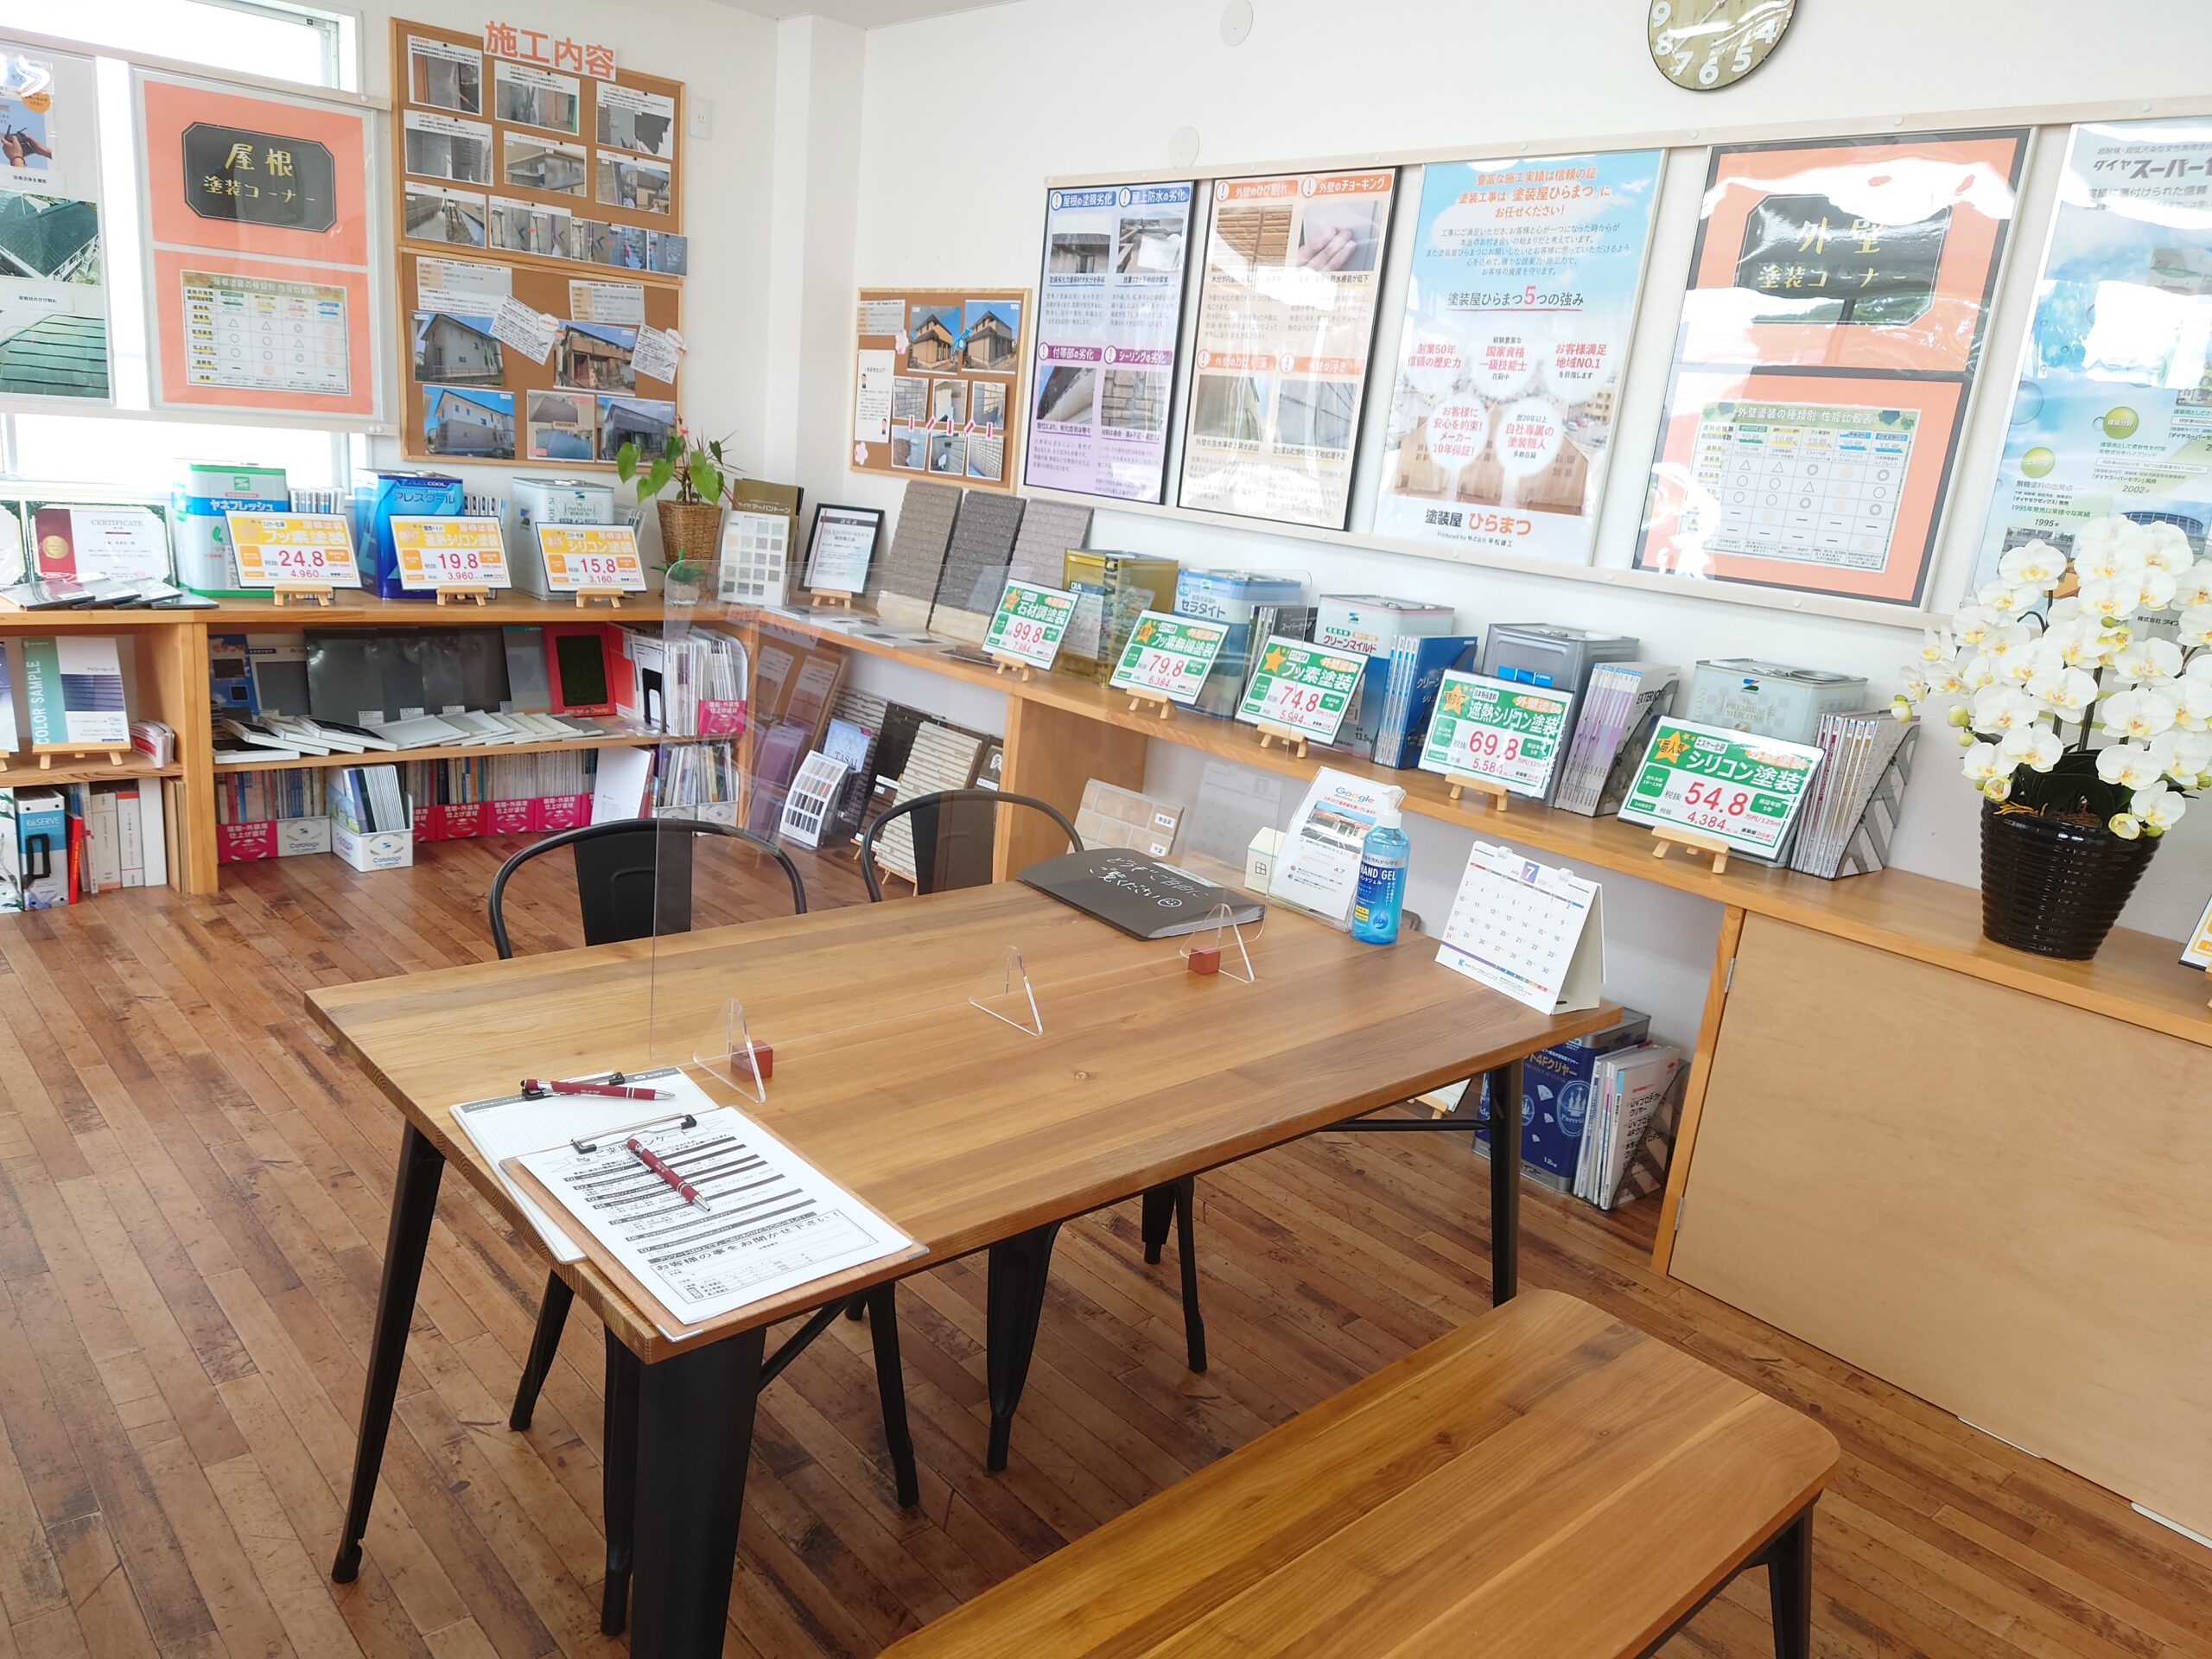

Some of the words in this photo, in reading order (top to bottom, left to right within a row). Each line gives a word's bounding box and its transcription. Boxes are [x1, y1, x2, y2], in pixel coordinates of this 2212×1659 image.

[1653, 2, 1671, 28] 9
[1755, 21, 1777, 43] 4
[486, 21, 615, 79] 施工内容
[1656, 31, 1673, 55] 8
[1673, 51, 1694, 76] 7
[1731, 47, 1753, 72] 5
[1699, 57, 1719, 84] 6
[226, 143, 293, 176] 屋根
[1476, 167, 1597, 187] 豊富な施工実績は信頼の証
[204, 175, 315, 203] 塗装コーナー
[1235, 183, 1287, 198] 外壁のひび割れ
[1319, 177, 1385, 194] 外壁のチョーキング
[1063, 194, 1113, 207] 屋根の塗膜劣化
[1132, 189, 1185, 203] 屋上防水の劣化
[1797, 217, 1889, 254] 外壁
[1758, 264, 1906, 289] 塗装コーナー
[1447, 285, 1585, 307] 塗装屋ひらまつ5つの強み
[1492, 336, 1522, 345] 経験豊富な
[1053, 348, 1094, 360] 付帯部の劣化
[1417, 343, 1456, 355] 創業50年
[1486, 346, 1526, 359] 国家資格
[1555, 343, 1607, 356] お客様満足
[1119, 351, 1166, 364] シーリングの劣化
[1408, 355, 1461, 369] 信頼の歴史力
[1479, 359, 1528, 372] 一級技能士
[1555, 356, 1600, 369] 地域NO.1
[1559, 371, 1593, 379] を目指します
[1442, 406, 1478, 417] お客様に
[1737, 407, 1817, 422] 外壁塗装の種類別
[1821, 410, 1872, 424] 性能比較表
[1440, 433, 1471, 442] メーカー
[1506, 423, 1554, 436] 自社専属の
[1508, 436, 1546, 450] 塗装職人
[210, 499, 275, 511] ヤネフレッシュ
[394, 492, 455, 504] アレスクール
[1425, 508, 1463, 528] 塗装屋
[1468, 512, 1532, 536] ひらまつ
[264, 531, 346, 544] フッ素塗装
[568, 541, 633, 553] シリコン塗装
[278, 550, 324, 568] 24.8
[438, 553, 478, 569] 19.8
[581, 558, 616, 574] 15.8
[1071, 582, 1082, 591] DIA
[1017, 601, 1067, 626] 石材調塗装
[1182, 600, 1226, 619] セラタイト
[1013, 622, 1042, 643] 99.8
[1151, 633, 1217, 658] フッ素無機塗装
[1324, 634, 1377, 654] クリーンマイルド
[1149, 655, 1185, 677] 79.8
[26, 661, 44, 703] SAMPLE
[1281, 662, 1353, 691] フッ素塗装
[1280, 686, 1319, 712] 74.8
[1726, 700, 1765, 715] PREMIUM
[1467, 702, 1561, 736] 遮熱シリコン塗装
[1726, 709, 1764, 723] SILICONE
[32, 707, 49, 744] COLOR
[1470, 730, 1519, 760] 69.8
[1686, 750, 1805, 794] シリコン塗装
[1336, 787, 1374, 803] Google
[1664, 790, 1681, 802] 税抜
[1685, 781, 1749, 817] 54.8
[1687, 811, 1726, 831] 4,384
[289, 841, 320, 849] Catalogs
[373, 855, 401, 864] Catalogs
[1361, 865, 1378, 878] HAND
[1382, 870, 1395, 880] GEL
[1524, 866, 1535, 880] 7
[1630, 1092, 1661, 1108] UVプロテクト
[1630, 1108, 1647, 1117] クリヤー
[597, 1130, 690, 1156] ご来場ンケート
